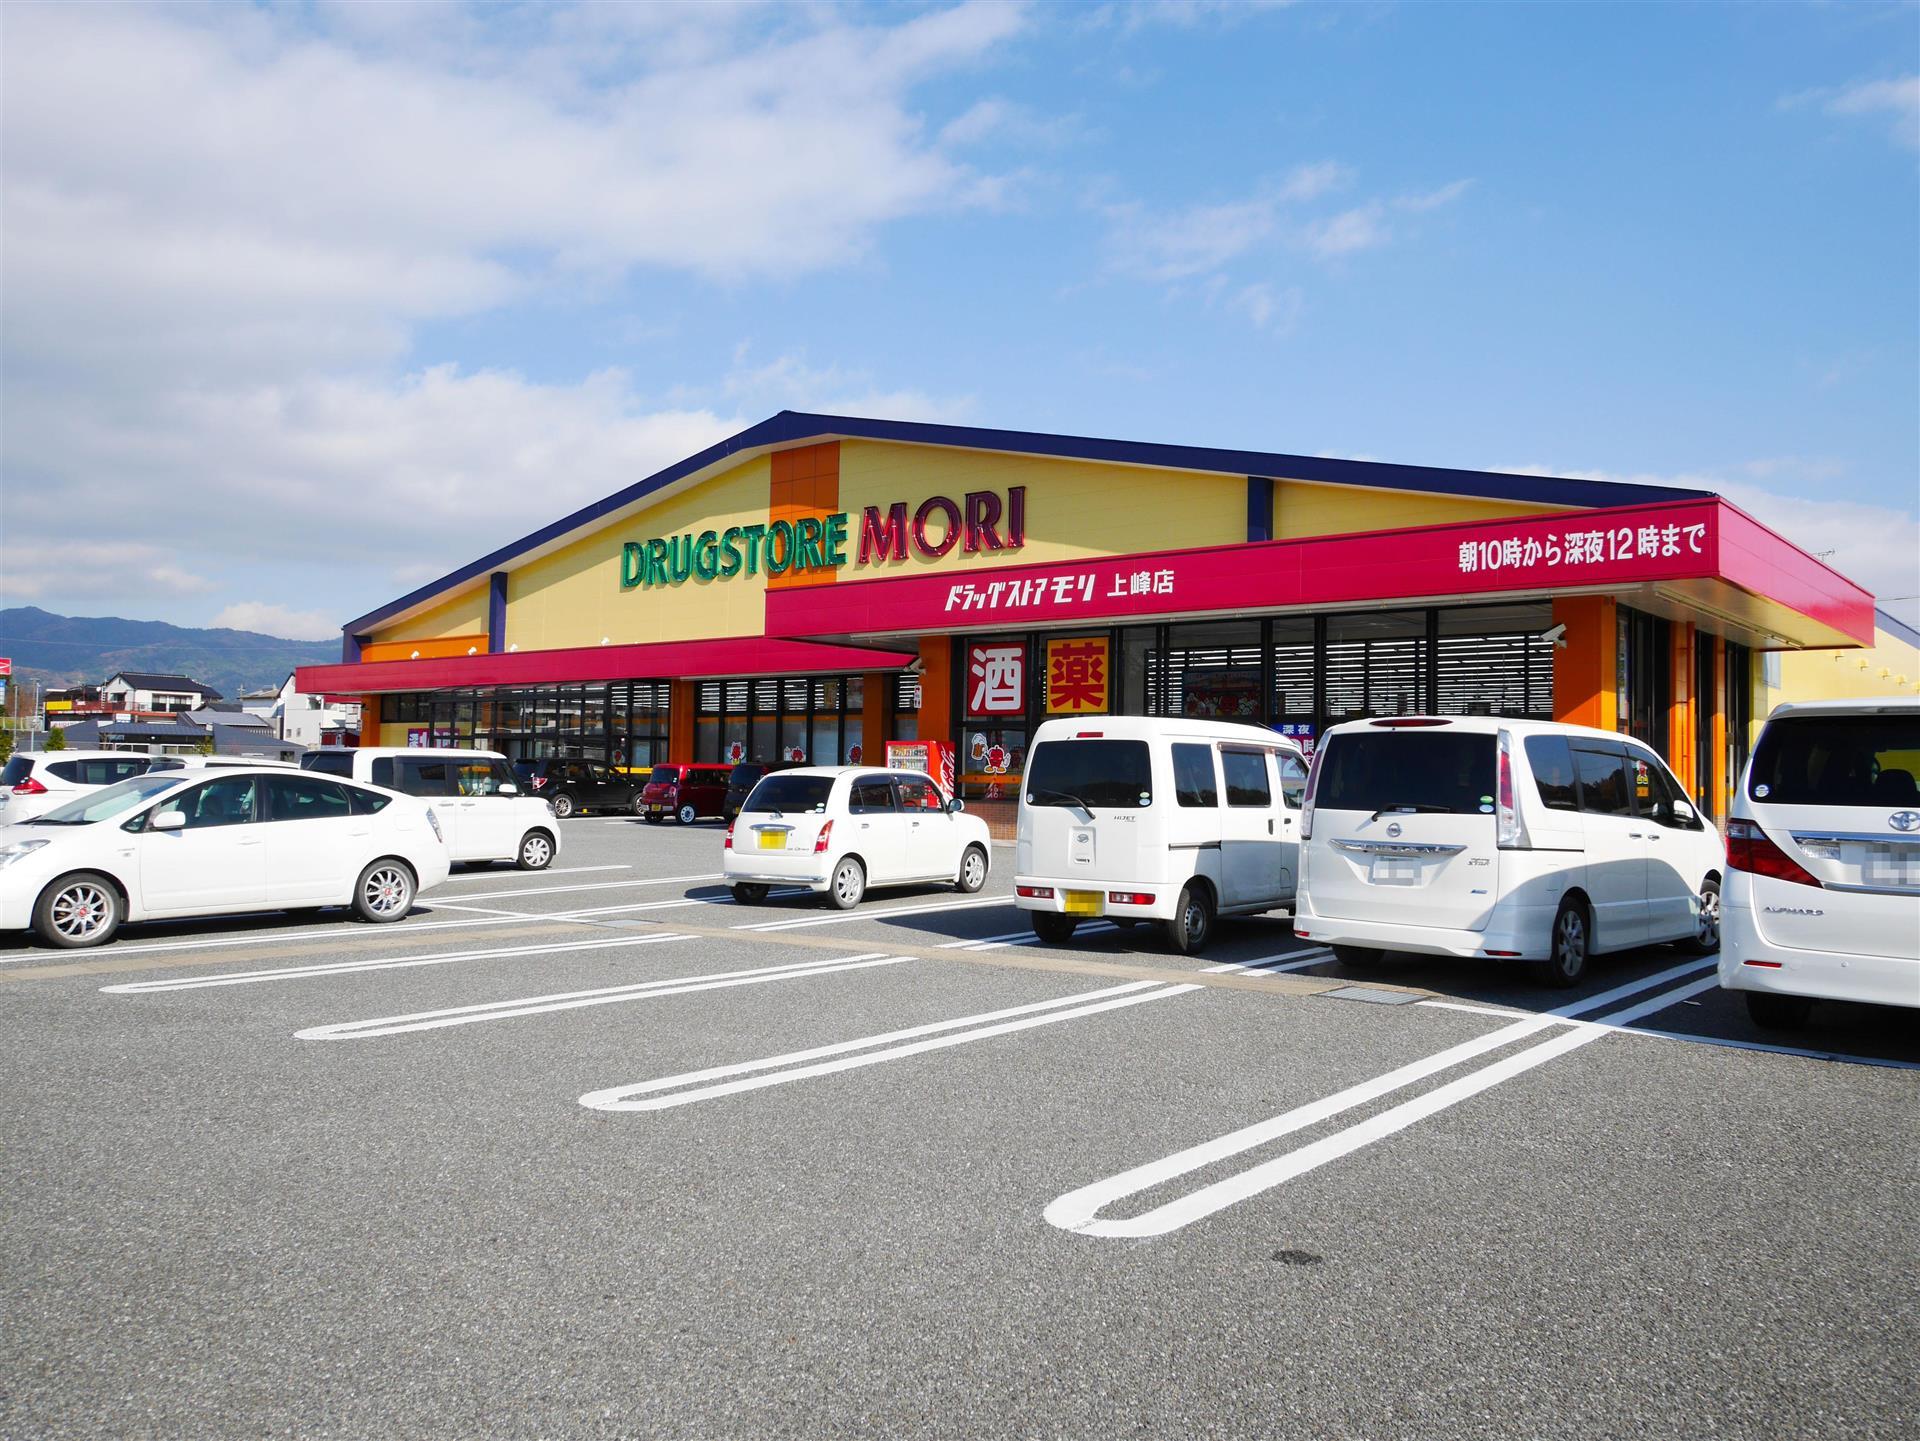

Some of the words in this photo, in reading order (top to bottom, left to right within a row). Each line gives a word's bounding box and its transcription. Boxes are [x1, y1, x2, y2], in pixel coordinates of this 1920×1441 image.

[622, 512, 849, 588] DRUGSTORE
[858, 486, 1026, 564] MORI
[1458, 523, 1706, 573] 朝10時から深夜12時まで
[944, 573, 1096, 612] ドラッグストアモリ
[1106, 569, 1175, 597] 上峰店
[970, 647, 1023, 711] 酒
[1050, 642, 1105, 709] 薬
[1281, 724, 1310, 735] 深夜
[1763, 906, 1825, 916] ALPHARD
